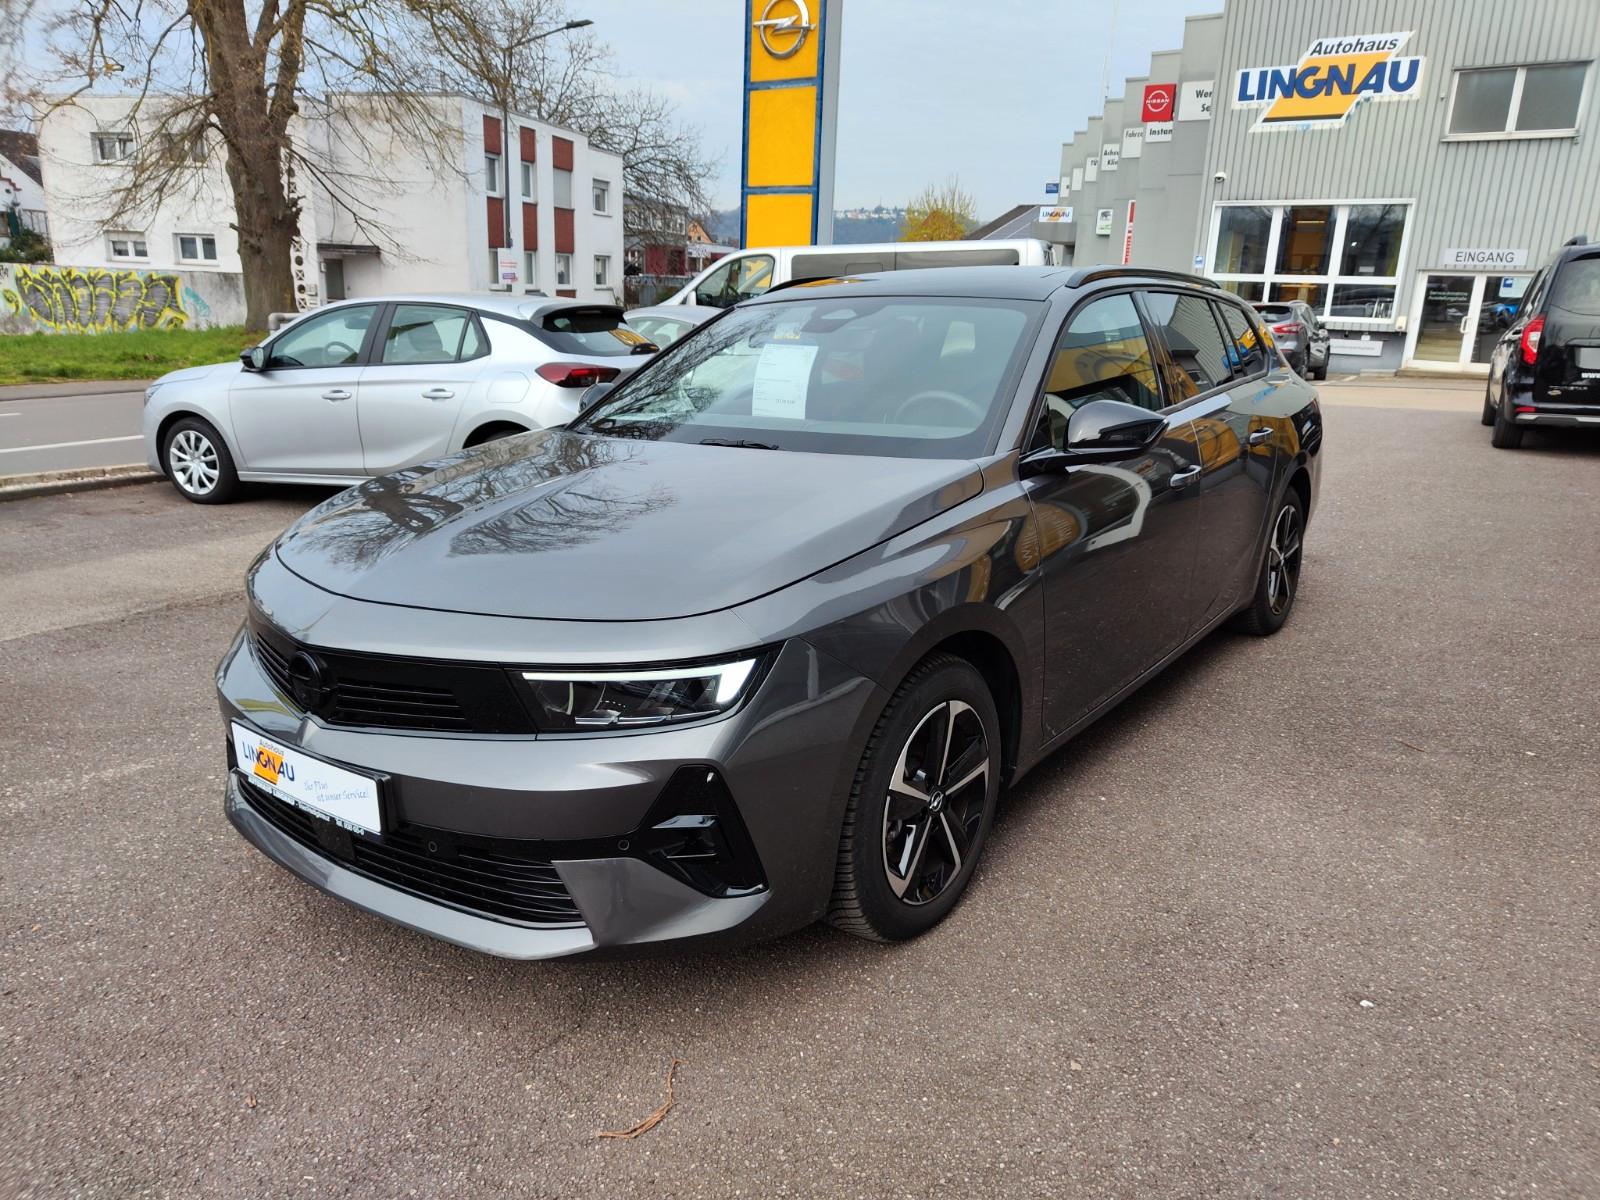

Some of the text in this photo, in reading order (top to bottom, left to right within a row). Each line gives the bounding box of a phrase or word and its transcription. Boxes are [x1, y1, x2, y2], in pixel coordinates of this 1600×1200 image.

[1309, 37, 1400, 56] Autohaus
[1237, 58, 1421, 102] LINGNAU
[1455, 251, 1515, 263] EINGANG
[242, 741, 295, 782] LINGNAU
